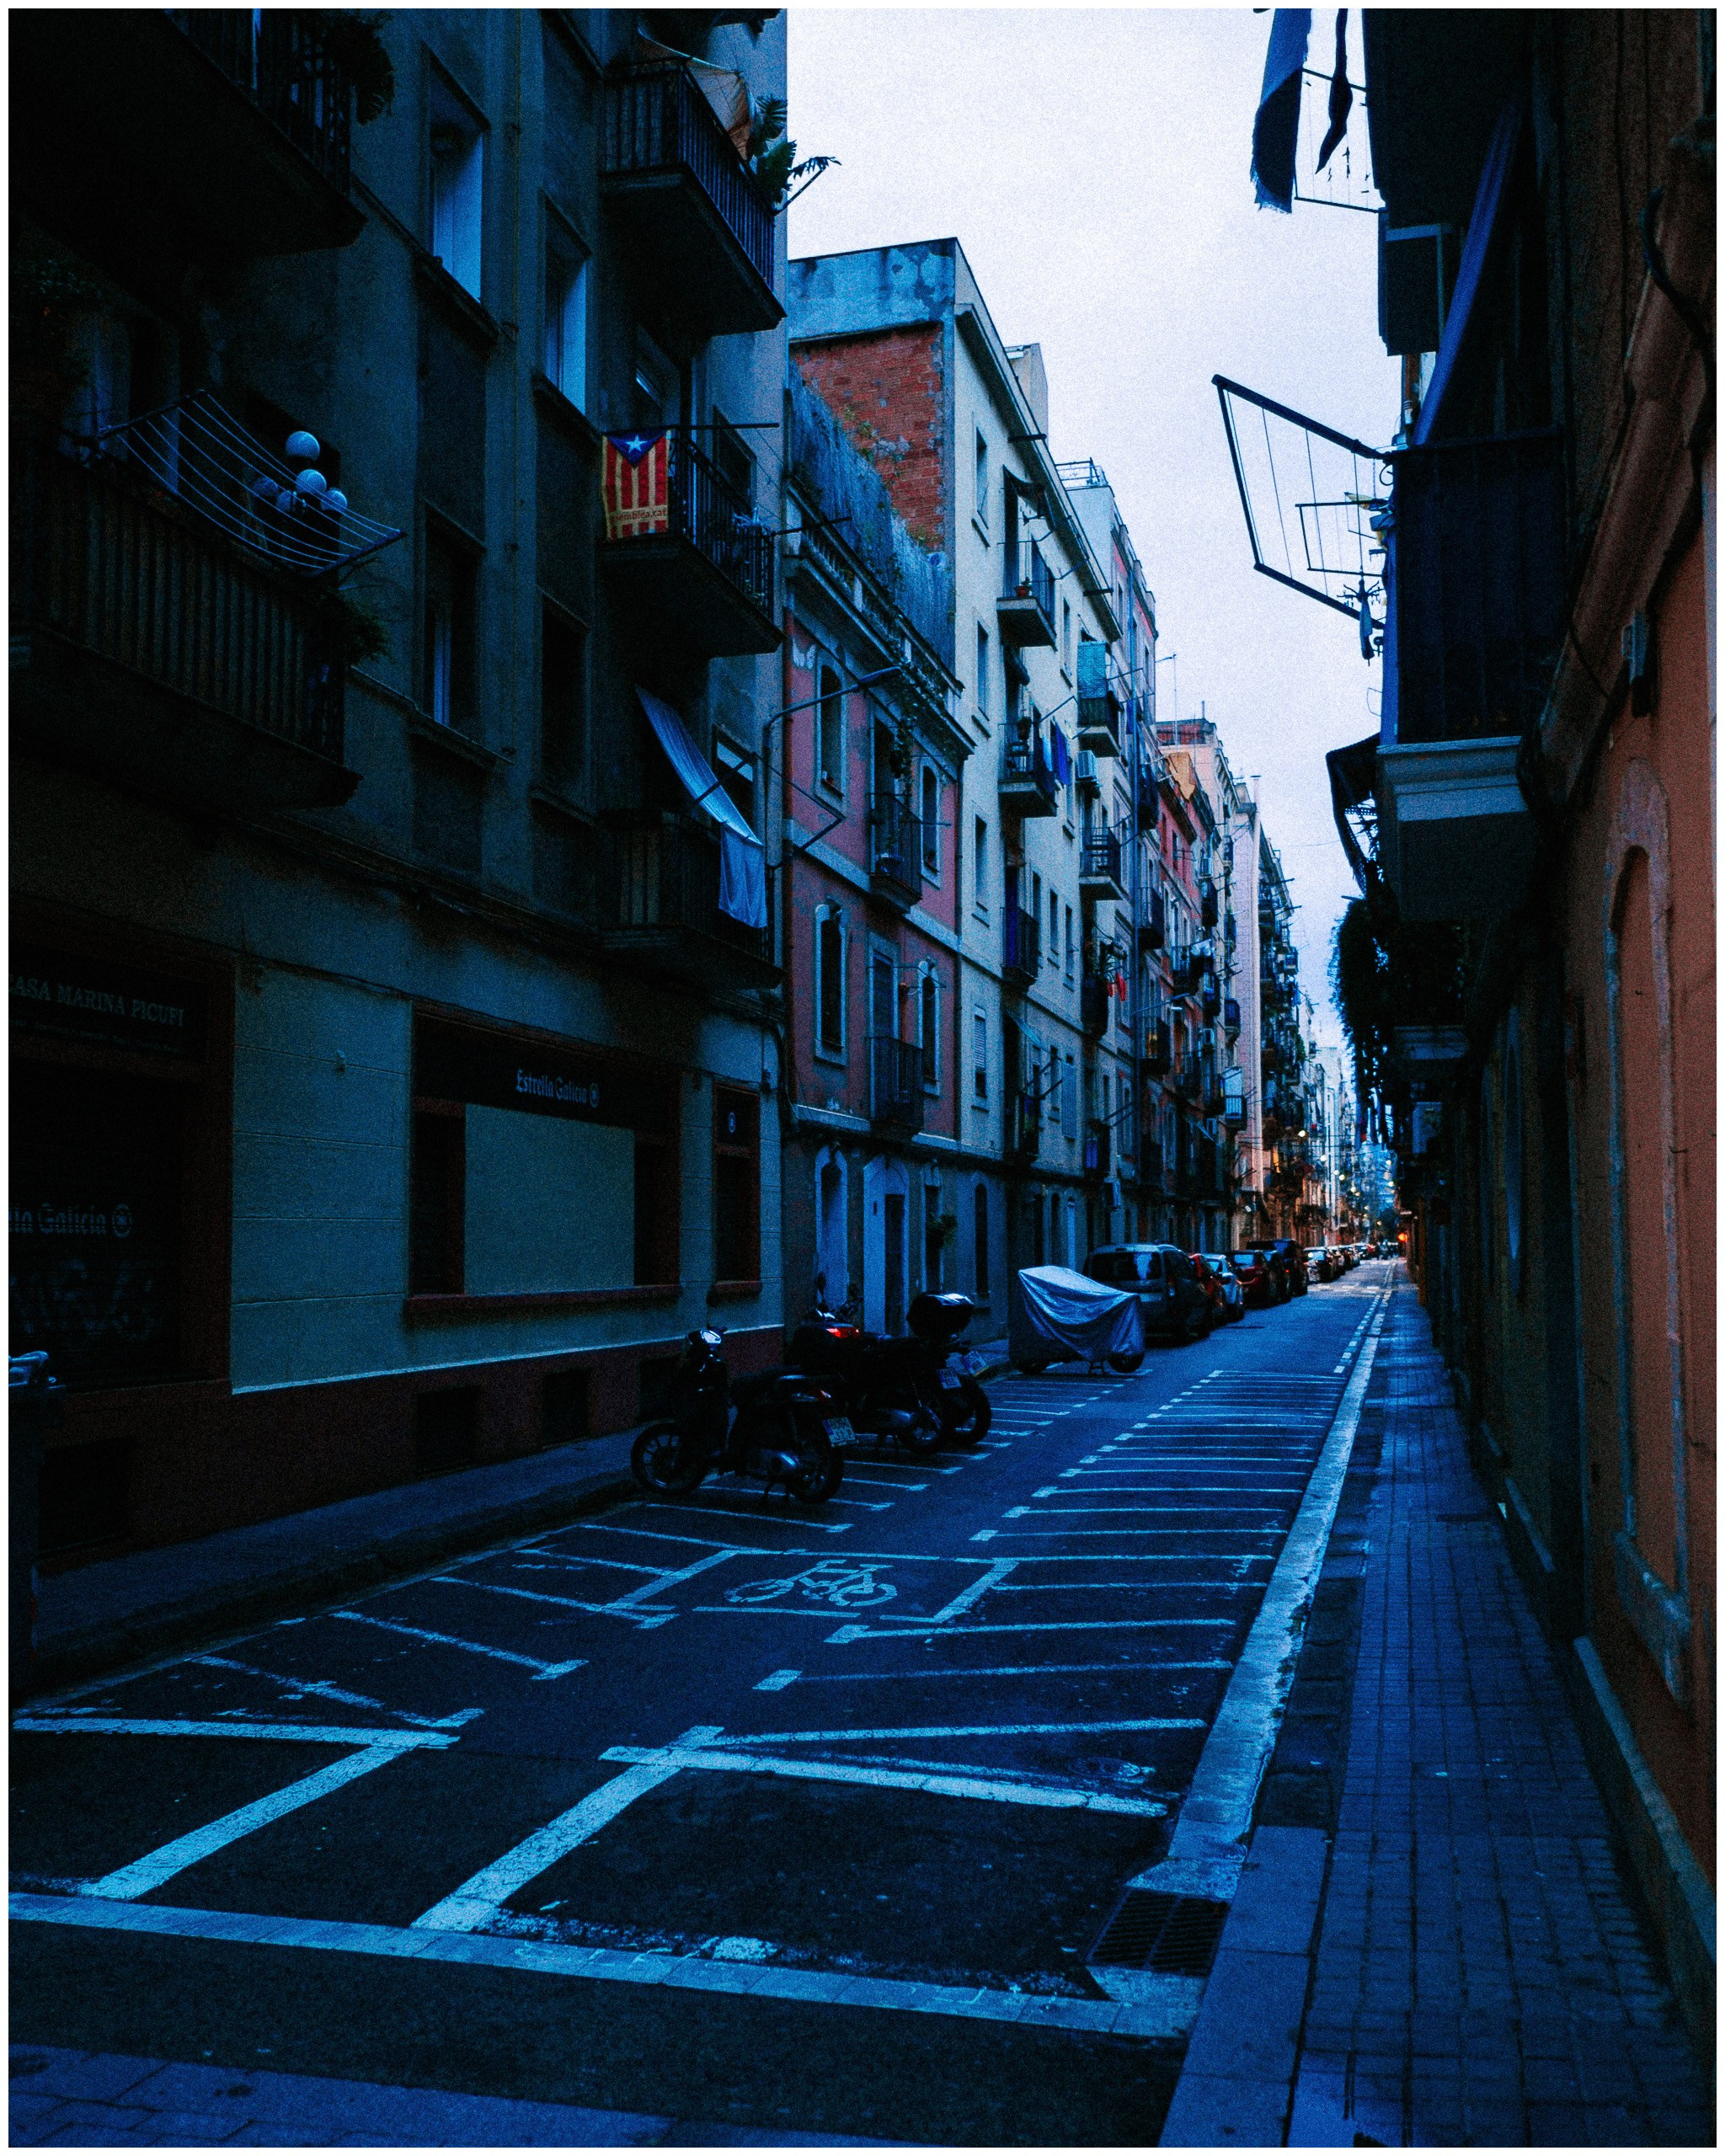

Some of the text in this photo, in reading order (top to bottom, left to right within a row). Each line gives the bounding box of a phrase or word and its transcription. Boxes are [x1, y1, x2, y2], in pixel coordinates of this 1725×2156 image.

[56, 982, 126, 1017] MARINA
[131, 998, 184, 1027] PICUFI
[515, 1068, 554, 1098] Estrella
